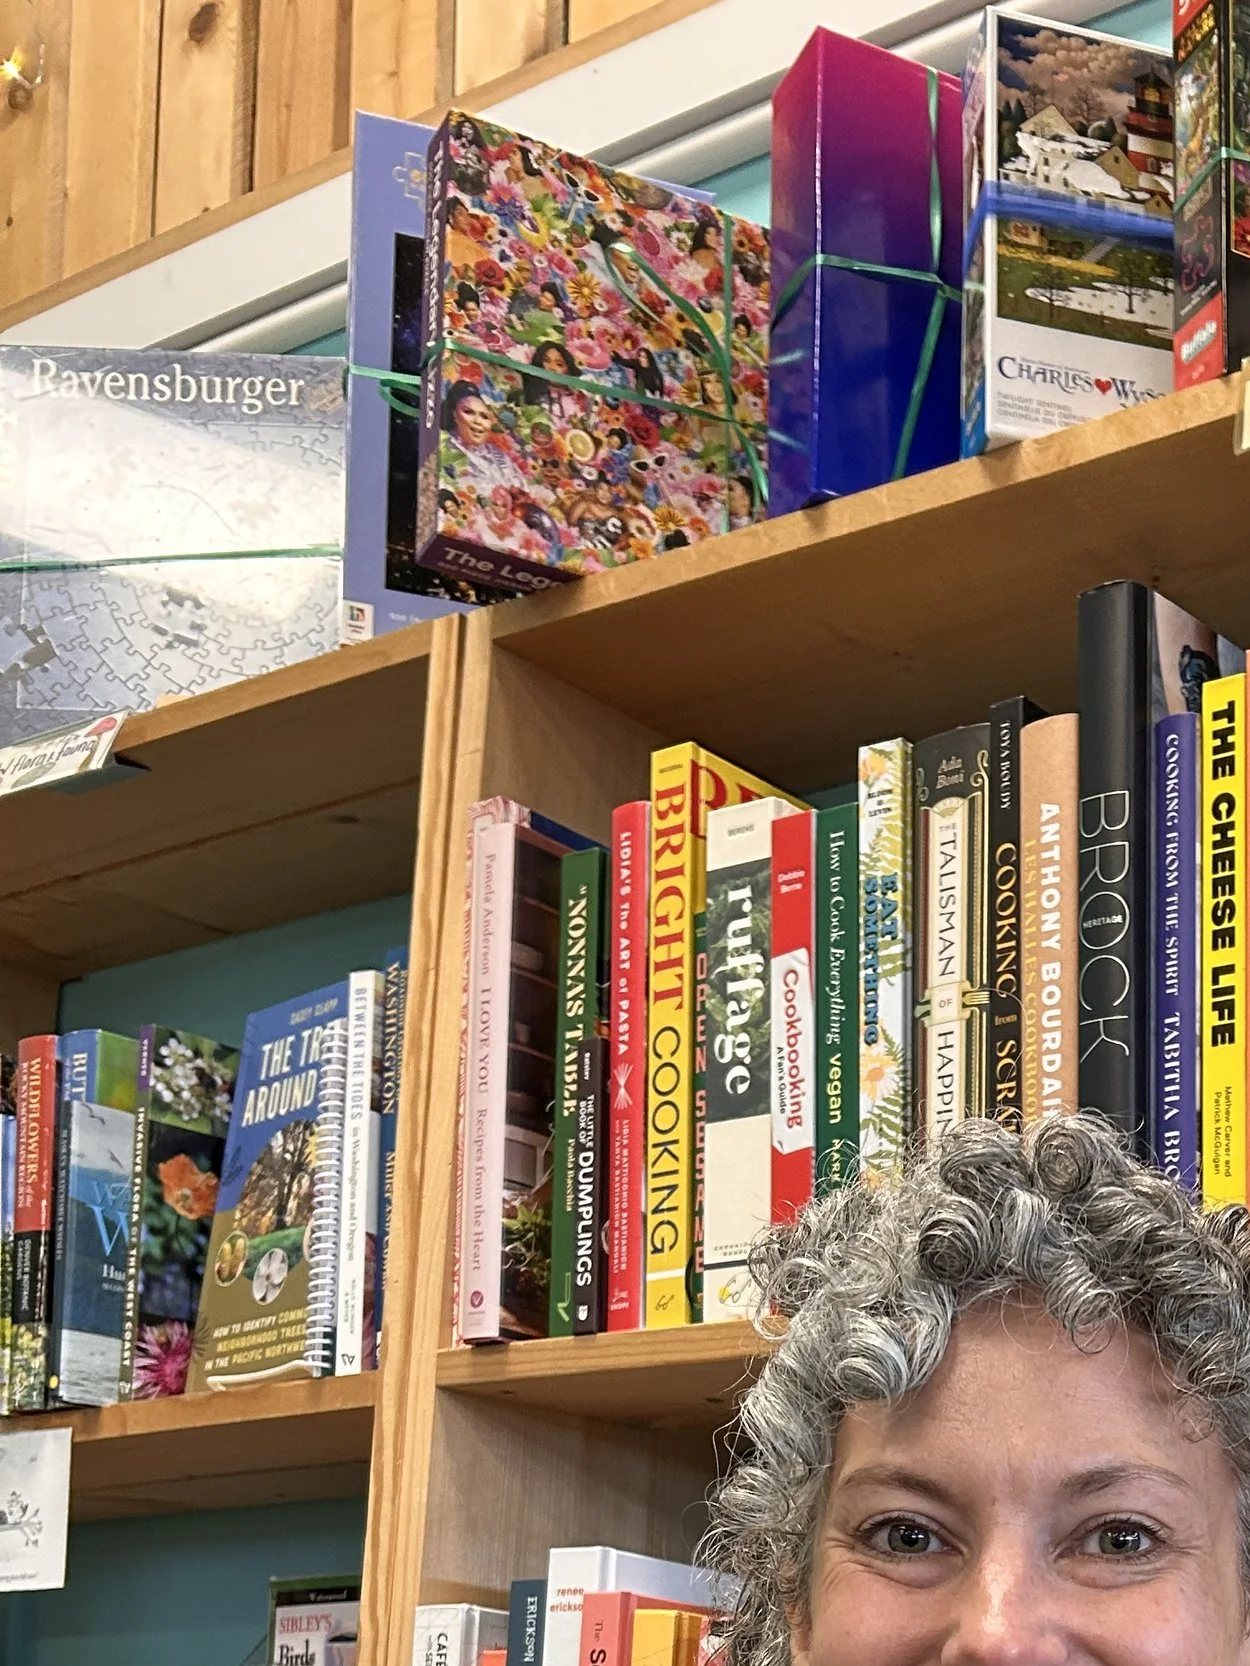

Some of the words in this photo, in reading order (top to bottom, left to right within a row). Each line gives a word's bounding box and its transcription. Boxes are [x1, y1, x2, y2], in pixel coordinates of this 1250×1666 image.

[30, 358, 305, 414] Ravensburger
[1211, 700, 1236, 780] THE
[652, 783, 687, 1012] BRIGHT
[1080, 790, 1130, 1063] BROCK
[1211, 792, 1236, 951] CHEESE
[381, 958, 401, 1116] WASHINGTON
[714, 885, 764, 1094] ruffage
[781, 969, 803, 1130] Cookbooking
[1211, 964, 1236, 1047] LIFE
[26, 1056, 42, 1185] WILDFLOWERS
[241, 1069, 319, 1127] AROUND
[260, 1034, 296, 1081] THE
[1164, 1013, 1180, 1120] TABITHA
[650, 1026, 681, 1255] COOKING
[576, 1151, 594, 1287] DUMPLINGS
[279, 1613, 333, 1635] SIBLEY'S
